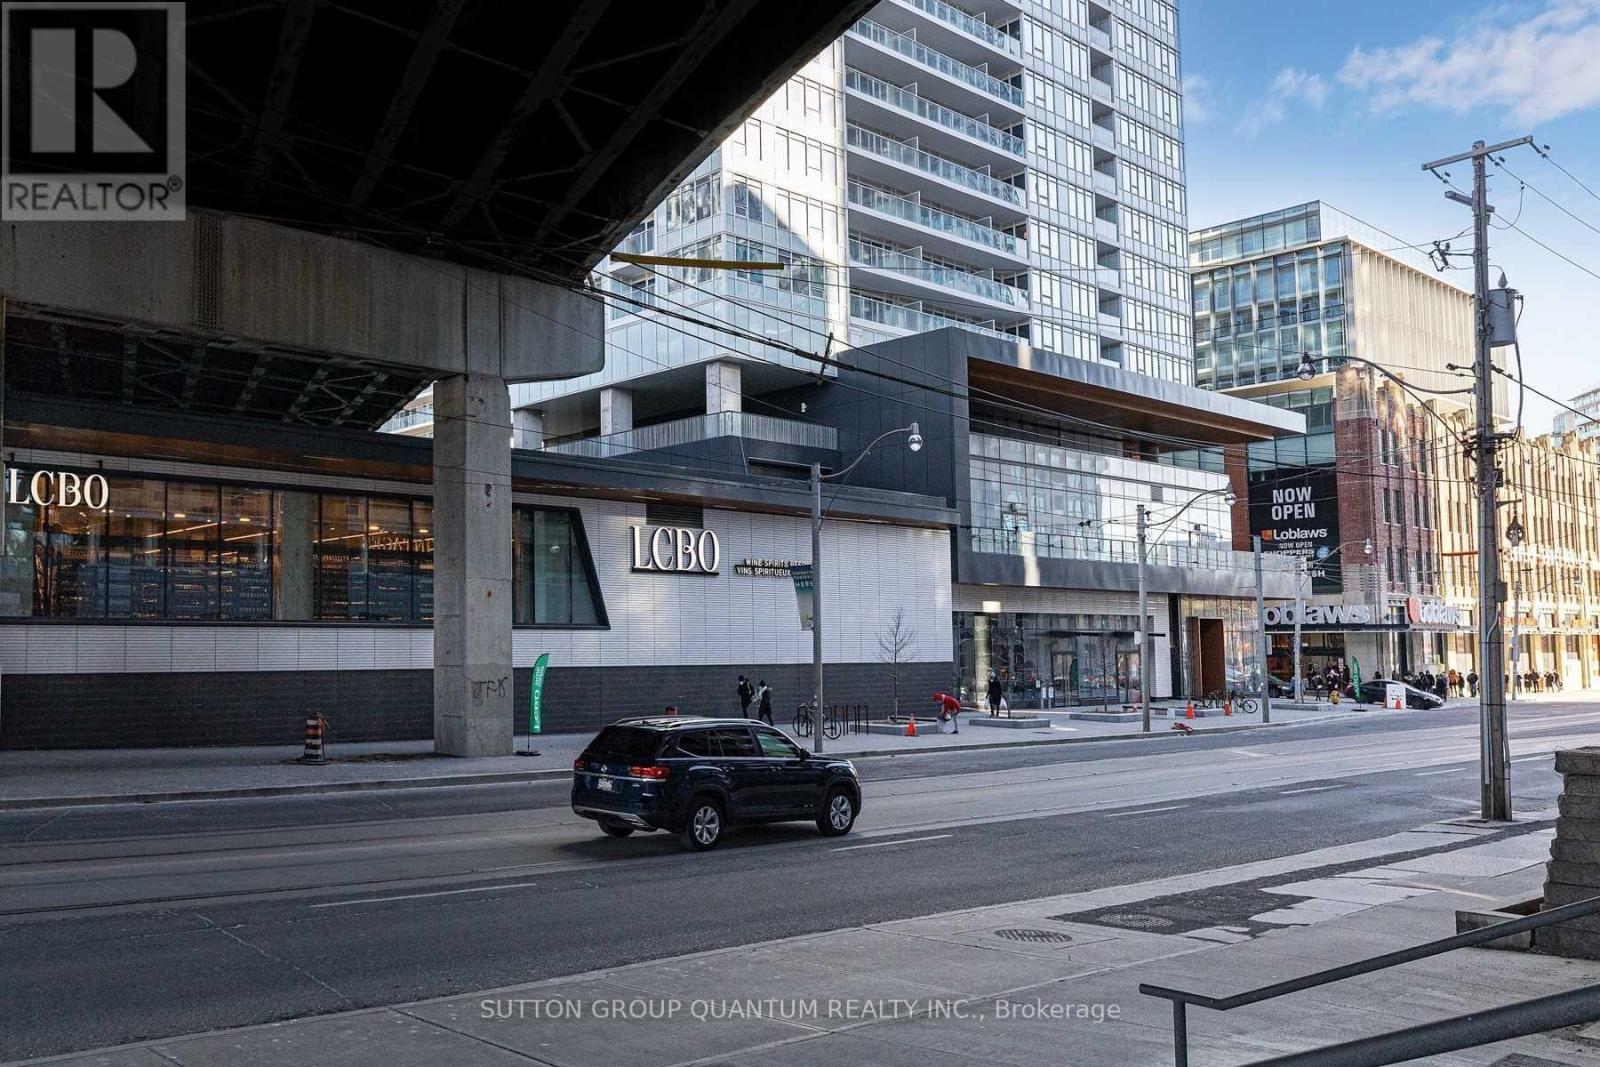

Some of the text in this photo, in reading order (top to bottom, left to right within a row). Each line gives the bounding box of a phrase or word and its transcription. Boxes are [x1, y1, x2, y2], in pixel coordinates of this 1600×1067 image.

[8, 468, 110, 509] LCBO
[1272, 486, 1312, 504] NOW
[1271, 502, 1316, 521] OPEN
[1273, 528, 1328, 541] Loblaws
[632, 525, 720, 574] LCBO
[1279, 541, 1313, 550] NOW OPEN
[736, 566, 752, 575] VINS
[754, 568, 791, 577] SPIRITUEUX
[745, 558, 764, 567] WINE
[764, 559, 789, 568] SPIRITS
[1264, 600, 1371, 626] oblaws
